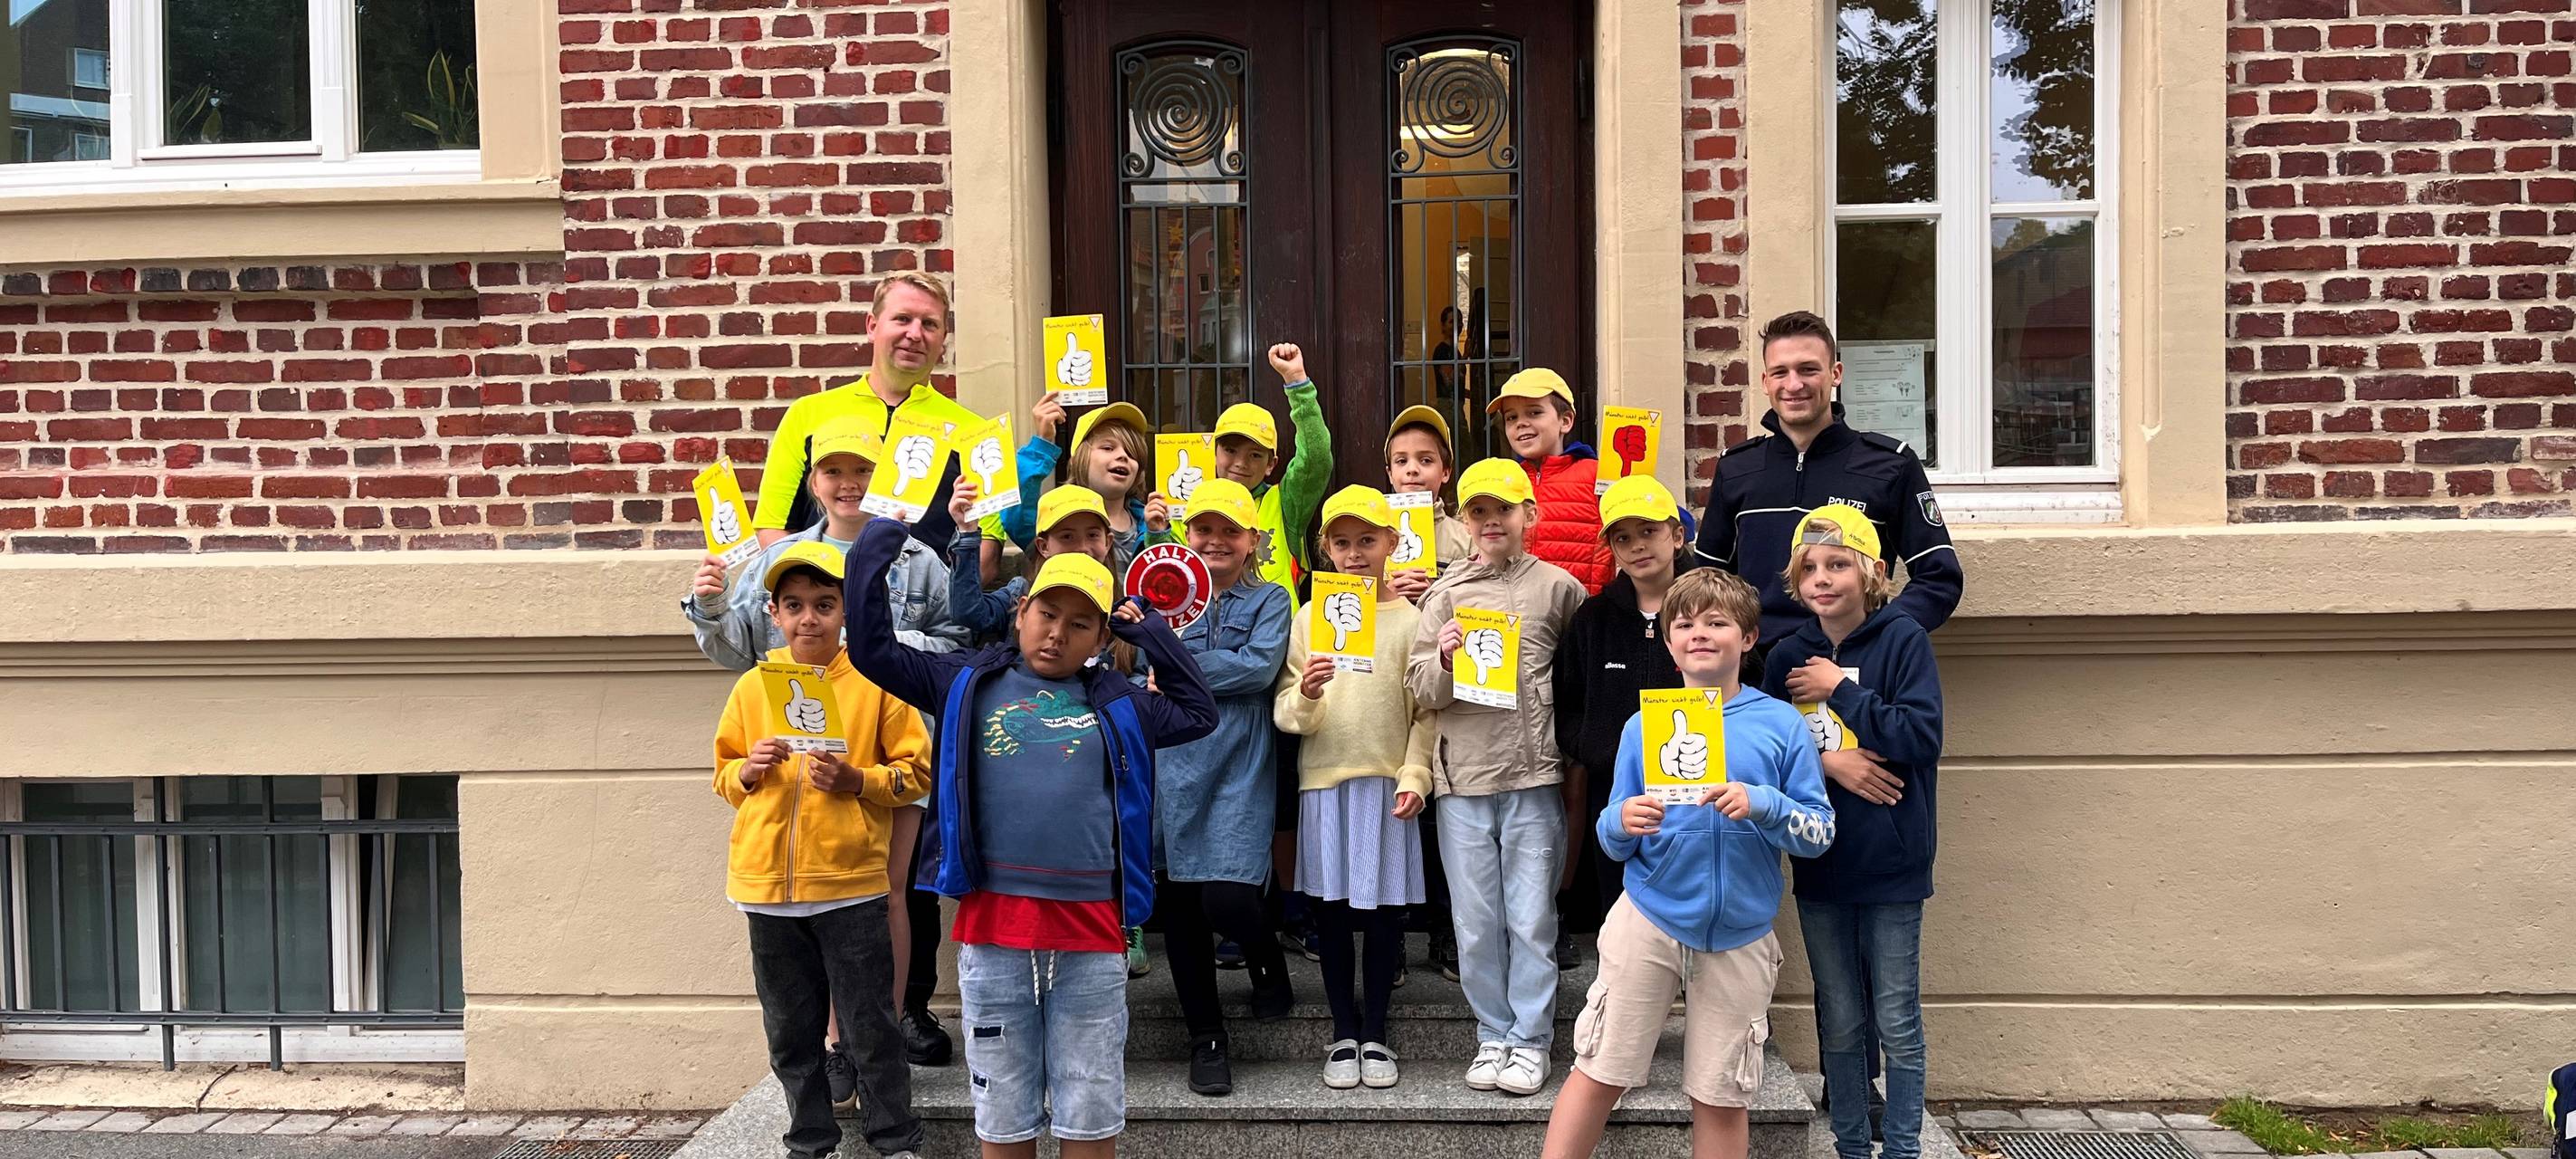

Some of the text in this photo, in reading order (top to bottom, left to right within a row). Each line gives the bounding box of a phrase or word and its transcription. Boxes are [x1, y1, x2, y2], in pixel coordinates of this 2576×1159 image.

[1828, 496, 1866, 512] POLIZEI
[1143, 547, 1194, 564] HALT
[1169, 599, 1205, 628] IZEI
